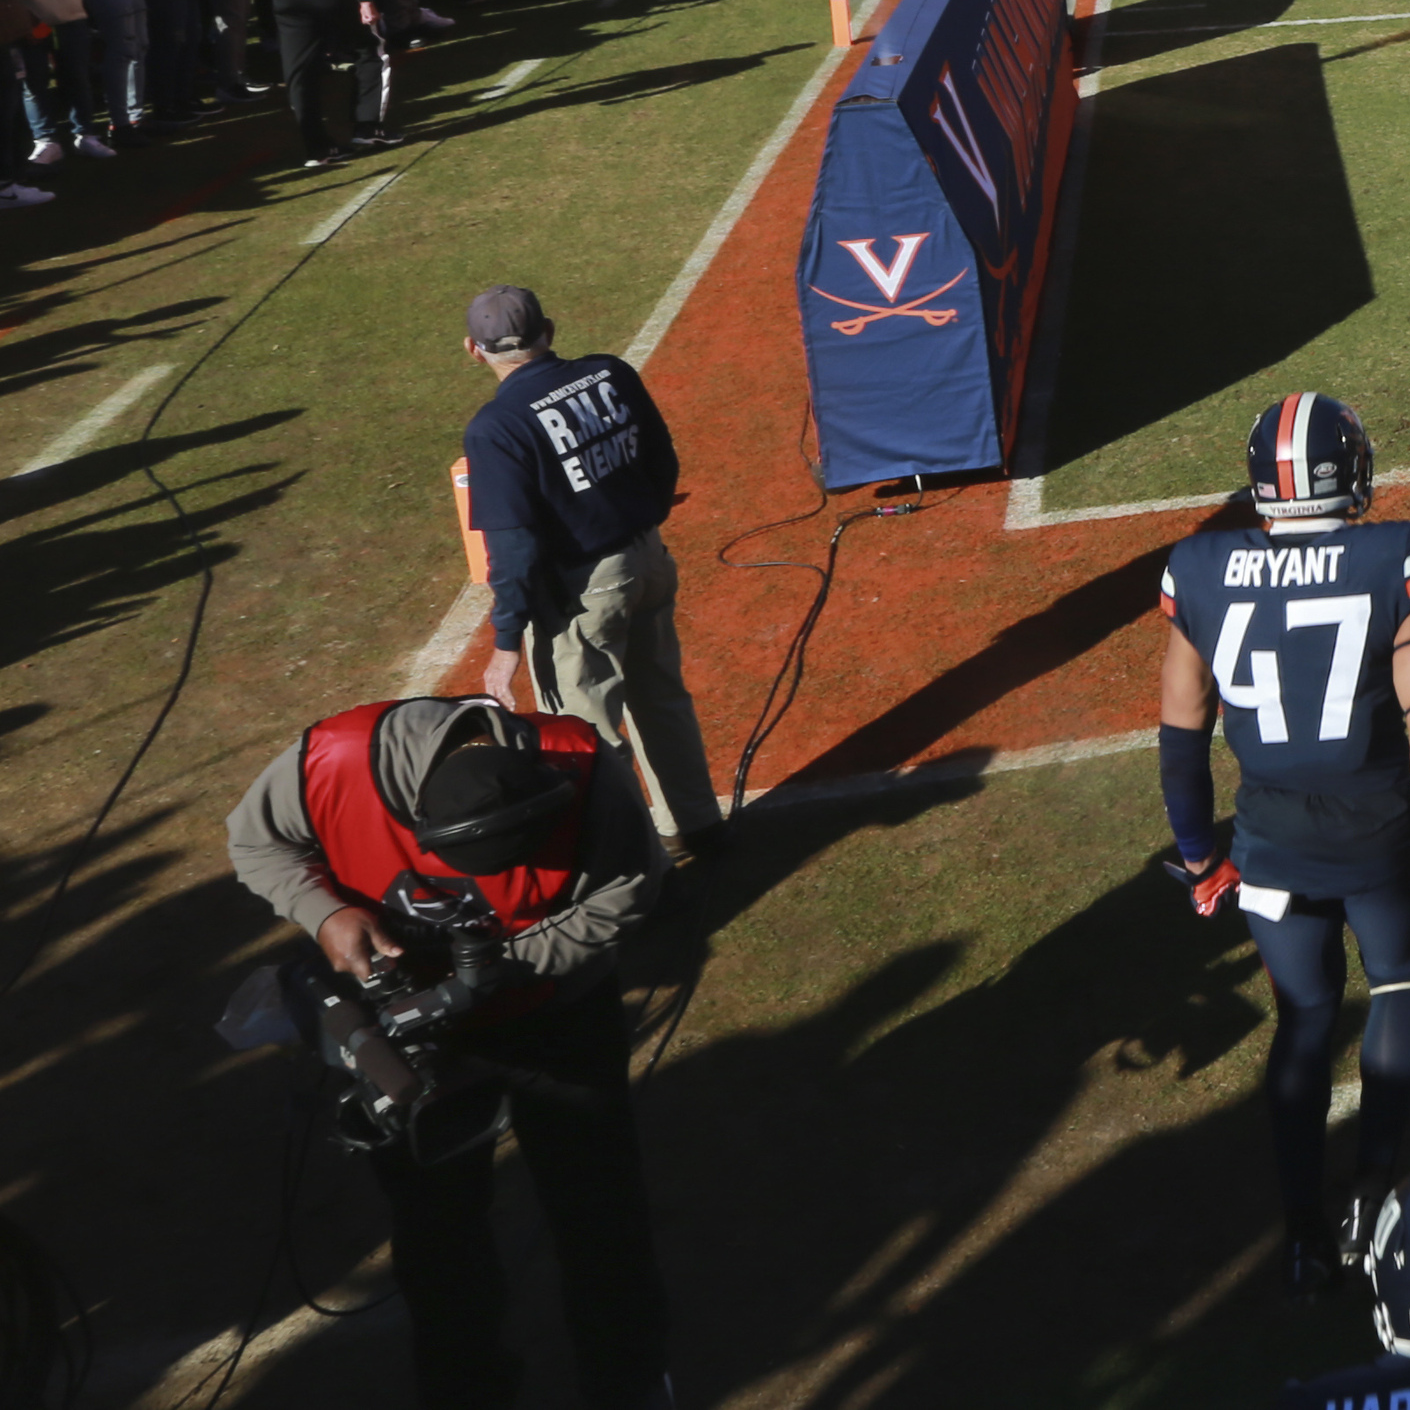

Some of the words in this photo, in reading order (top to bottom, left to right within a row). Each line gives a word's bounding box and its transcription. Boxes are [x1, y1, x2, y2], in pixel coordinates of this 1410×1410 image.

[561, 424, 638, 493] EVENTS
[1270, 503, 1324, 516] VIRGINIA
[1224, 545, 1345, 588] BRYANT
[1211, 593, 1372, 744] 47
